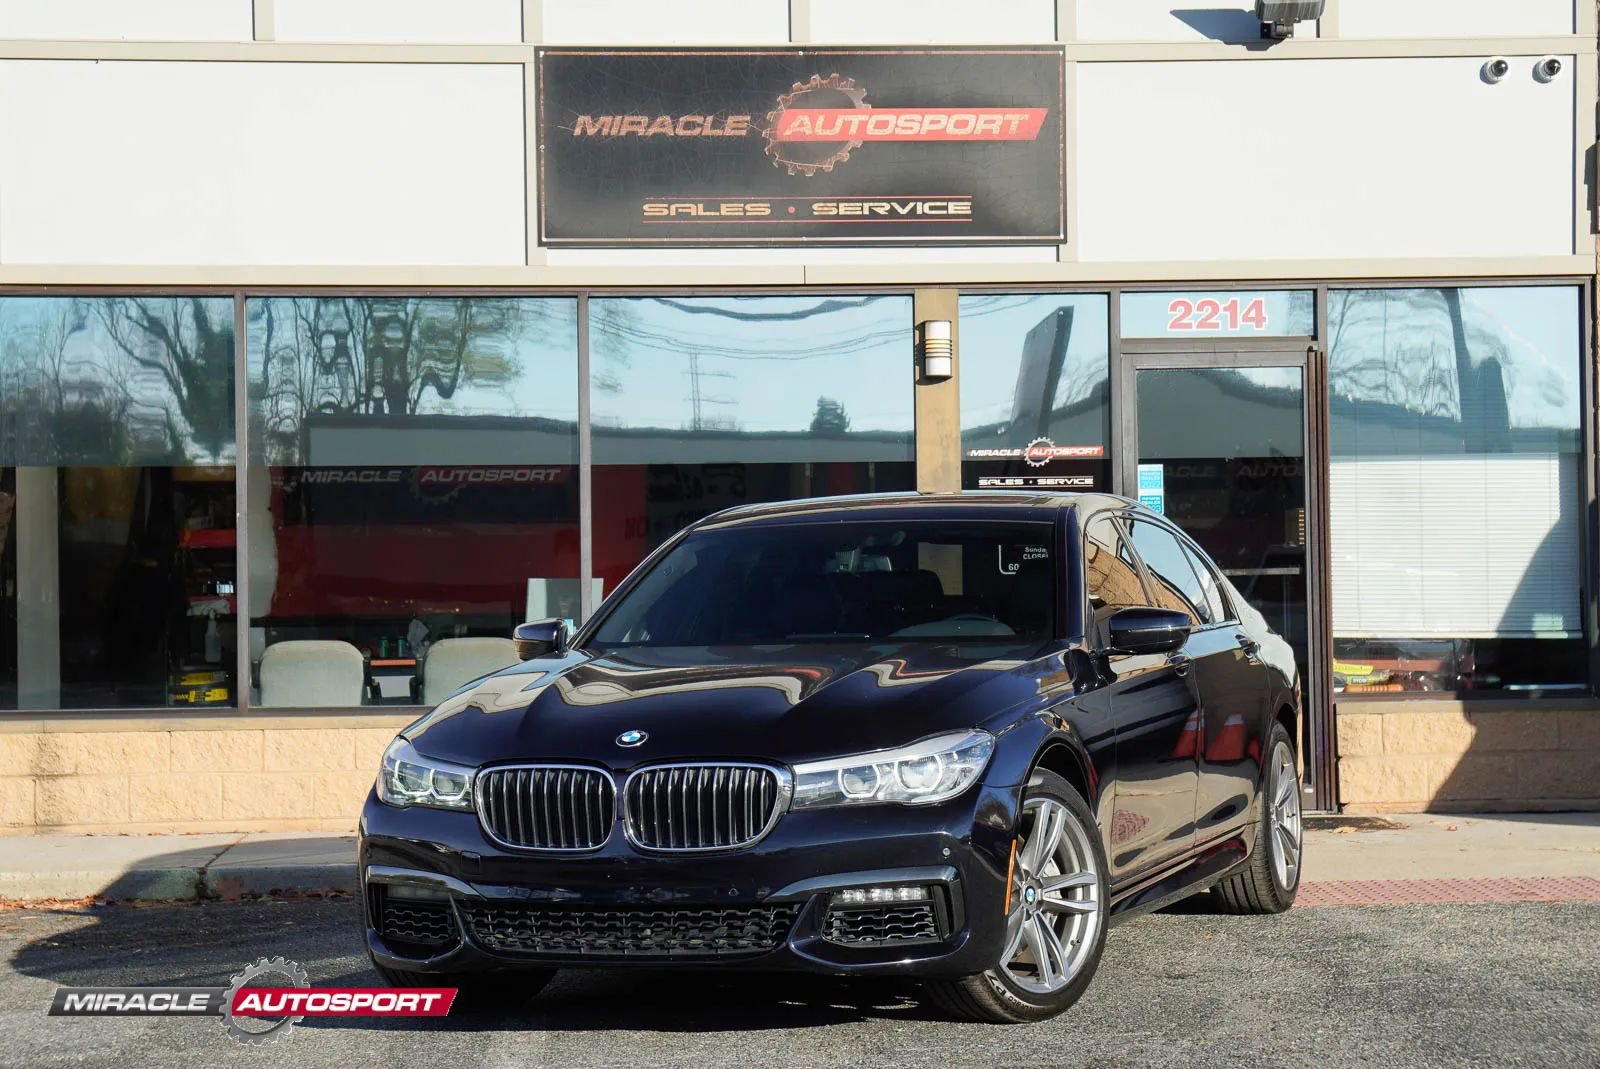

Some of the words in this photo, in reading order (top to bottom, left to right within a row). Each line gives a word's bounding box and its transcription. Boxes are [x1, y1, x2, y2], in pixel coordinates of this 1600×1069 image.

[573, 114, 752, 137] MIRACLE
[784, 113, 1030, 136] AUTOSPORT
[642, 202, 772, 217] SALES
[811, 201, 973, 216] SERVICE
[1167, 297, 1268, 330] 2214
[970, 448, 1021, 457] MIRACLE
[1030, 447, 1099, 456] AUTOSPORT
[300, 470, 402, 484] MIRACLE
[421, 469, 561, 483] AUTOSPORT
[978, 478, 1024, 486] SALES
[1037, 478, 1094, 486] SERVICE
